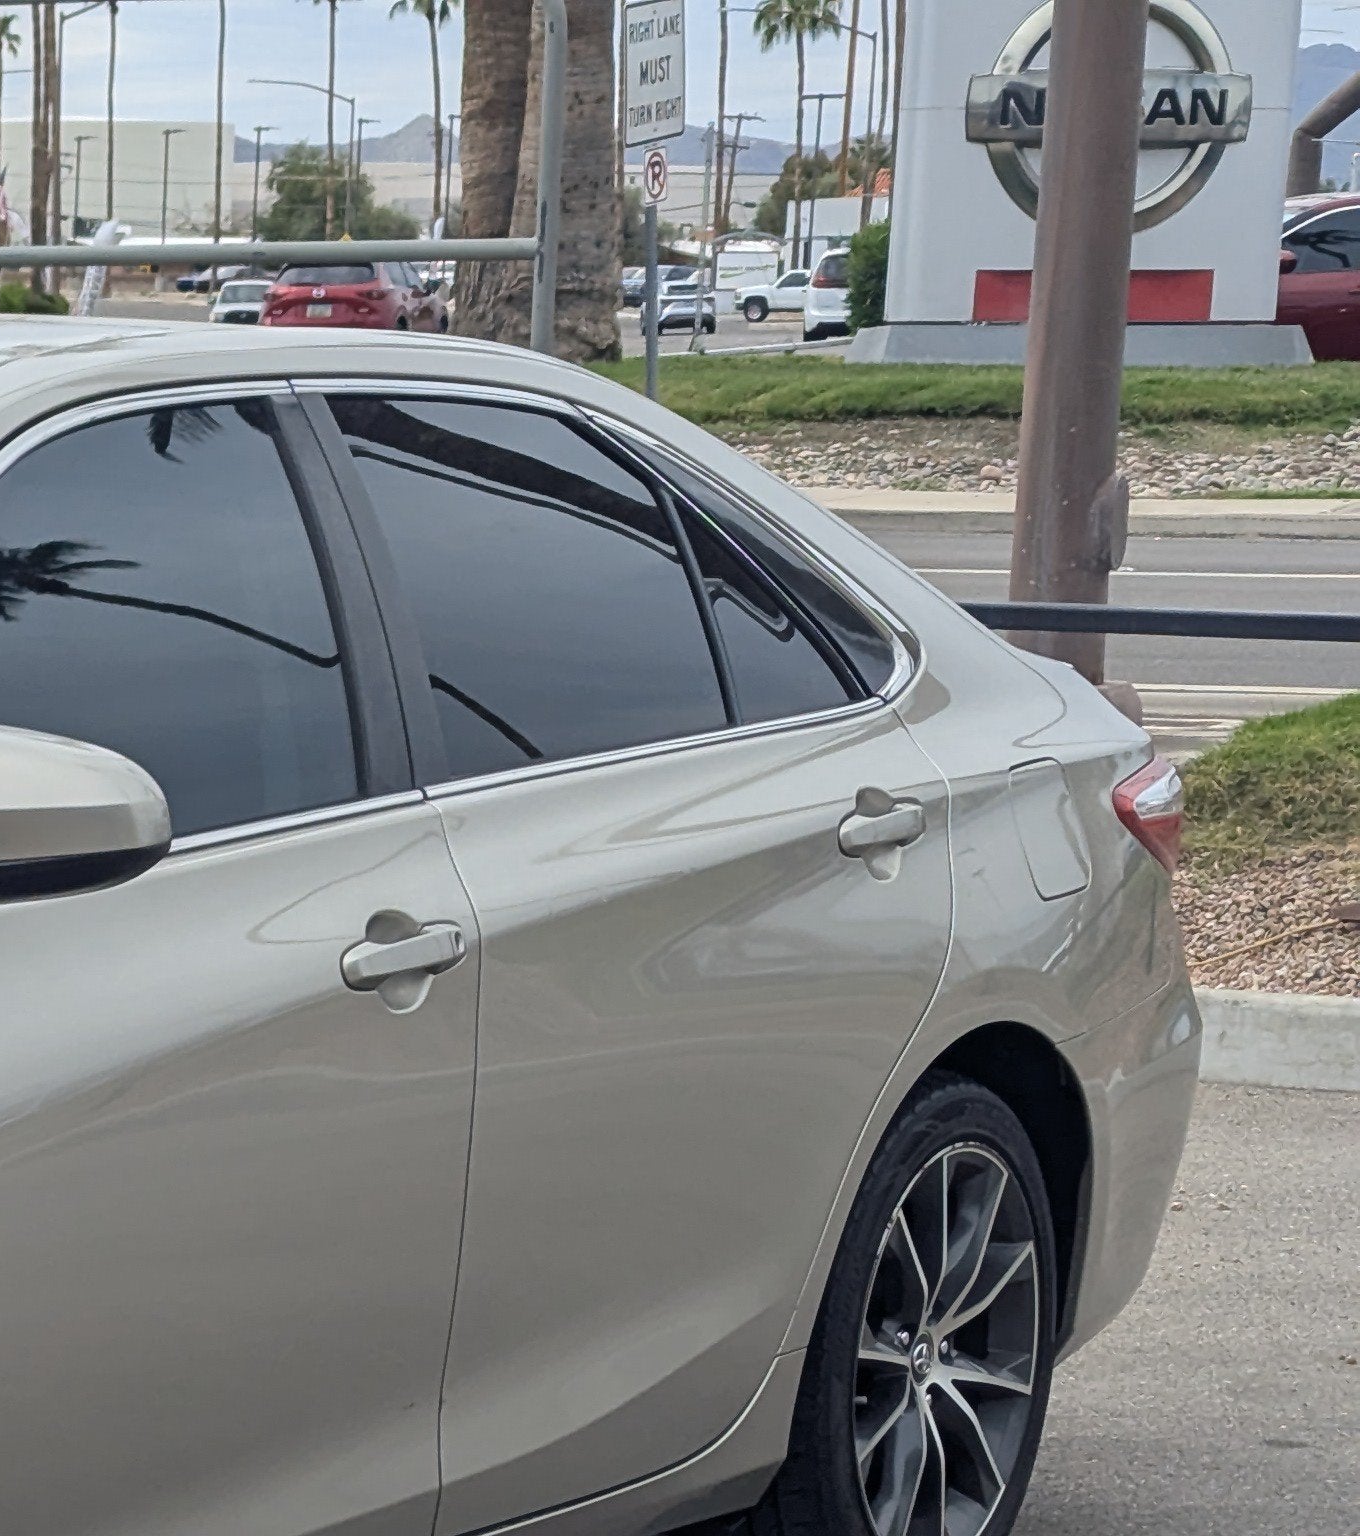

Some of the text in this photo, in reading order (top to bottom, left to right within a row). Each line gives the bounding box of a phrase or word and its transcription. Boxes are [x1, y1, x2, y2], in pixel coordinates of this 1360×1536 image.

[629, 14, 680, 44] RIGHT LANE
[640, 55, 672, 86] MUST
[629, 96, 681, 127] TURN RIGHT
[1000, 88, 1229, 126] NAN
